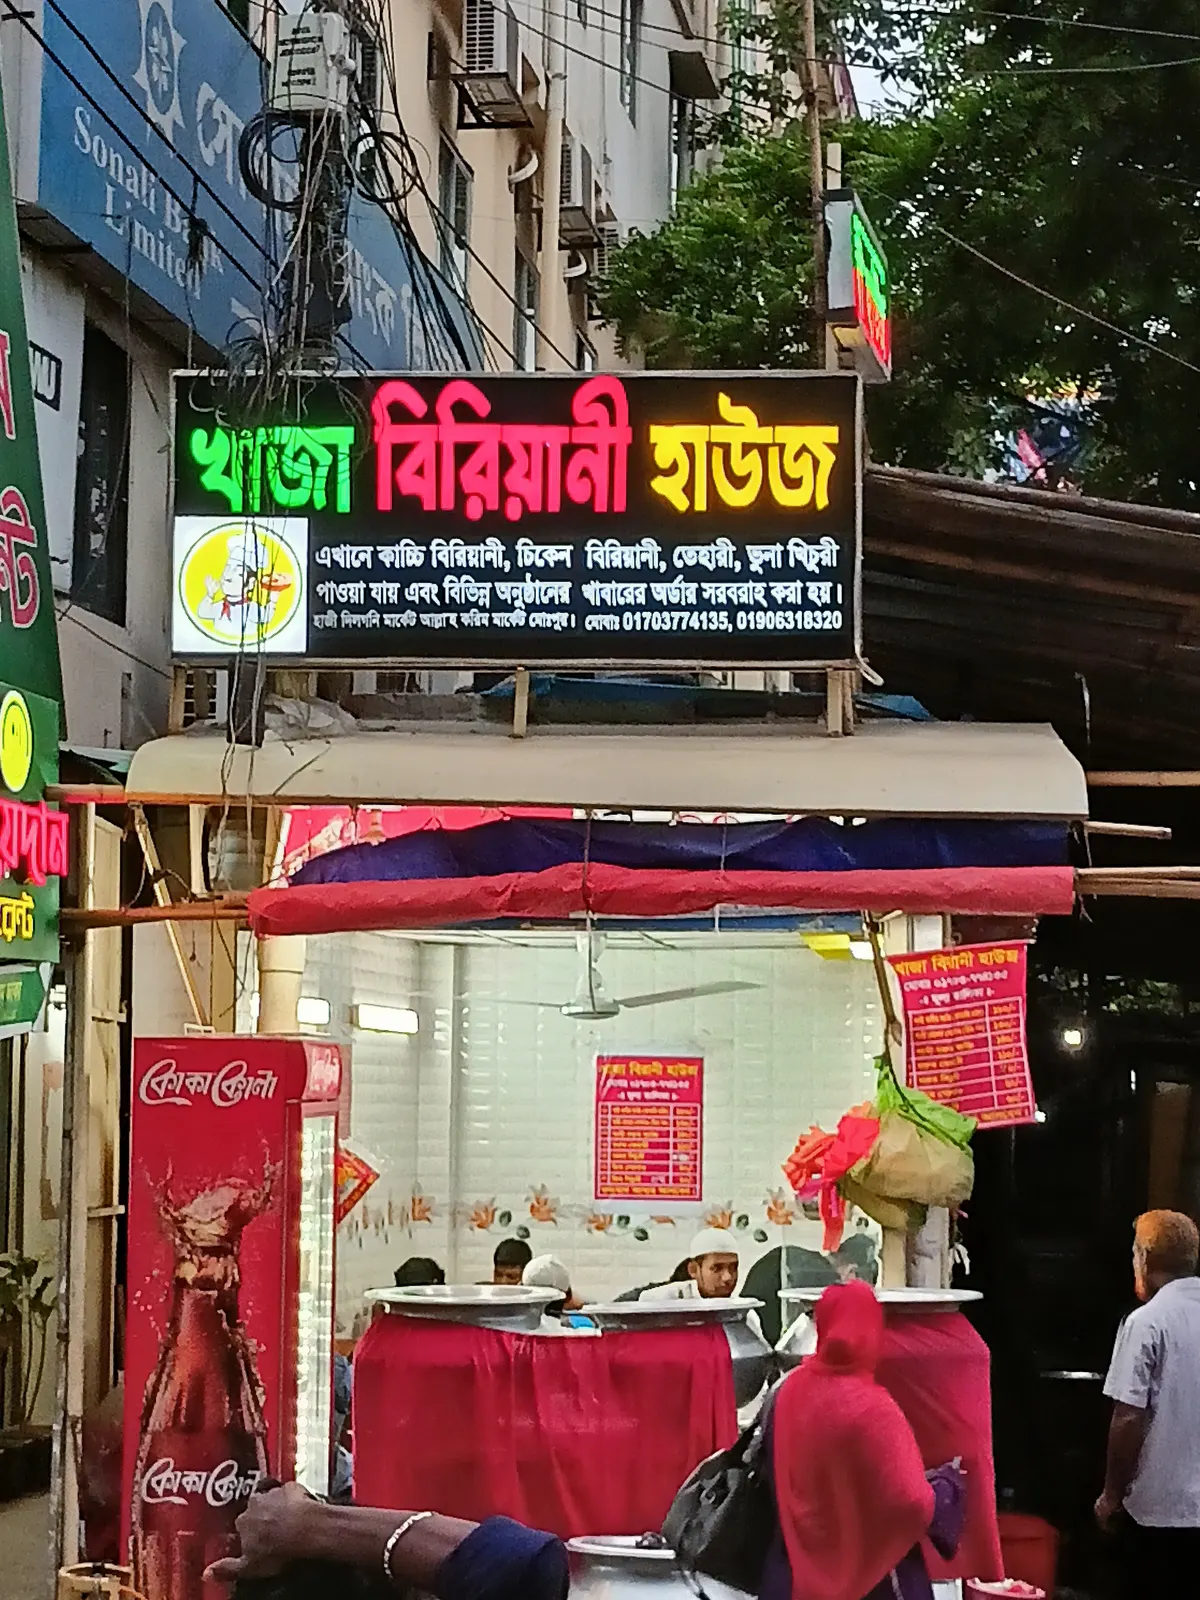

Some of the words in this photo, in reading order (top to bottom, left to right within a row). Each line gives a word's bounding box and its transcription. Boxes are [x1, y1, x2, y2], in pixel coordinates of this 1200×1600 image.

[75, 106, 157, 214] Sonali
[105, 182, 201, 299] Limited
[189, 425, 355, 513] খাজা
[371, 375, 632, 521] বিরিয়ানী
[648, 393, 840, 511] হাউজ
[315, 543, 375, 570] এখানে
[376, 538, 427, 570] কাচ্চি
[429, 536, 511, 572] বিরিয়ানী,
[515, 537, 574, 569] চিকেন
[585, 537, 667, 572] বিরিয়ানী,
[673, 536, 742, 573] তেহারী,
[745, 542, 785, 575] ভুনা
[315, 580, 367, 606] পাওয়া
[369, 580, 401, 606] যায়
[405, 582, 441, 606] এবং
[442, 575, 493, 608] বিভিন্ন
[581, 579, 648, 607] খাবারের
[650, 575, 699, 606] অর্ডার
[701, 580, 768, 608] সরবরাহ
[769, 579, 804, 606] করা
[736, 610, 843, 630] 01906318320
